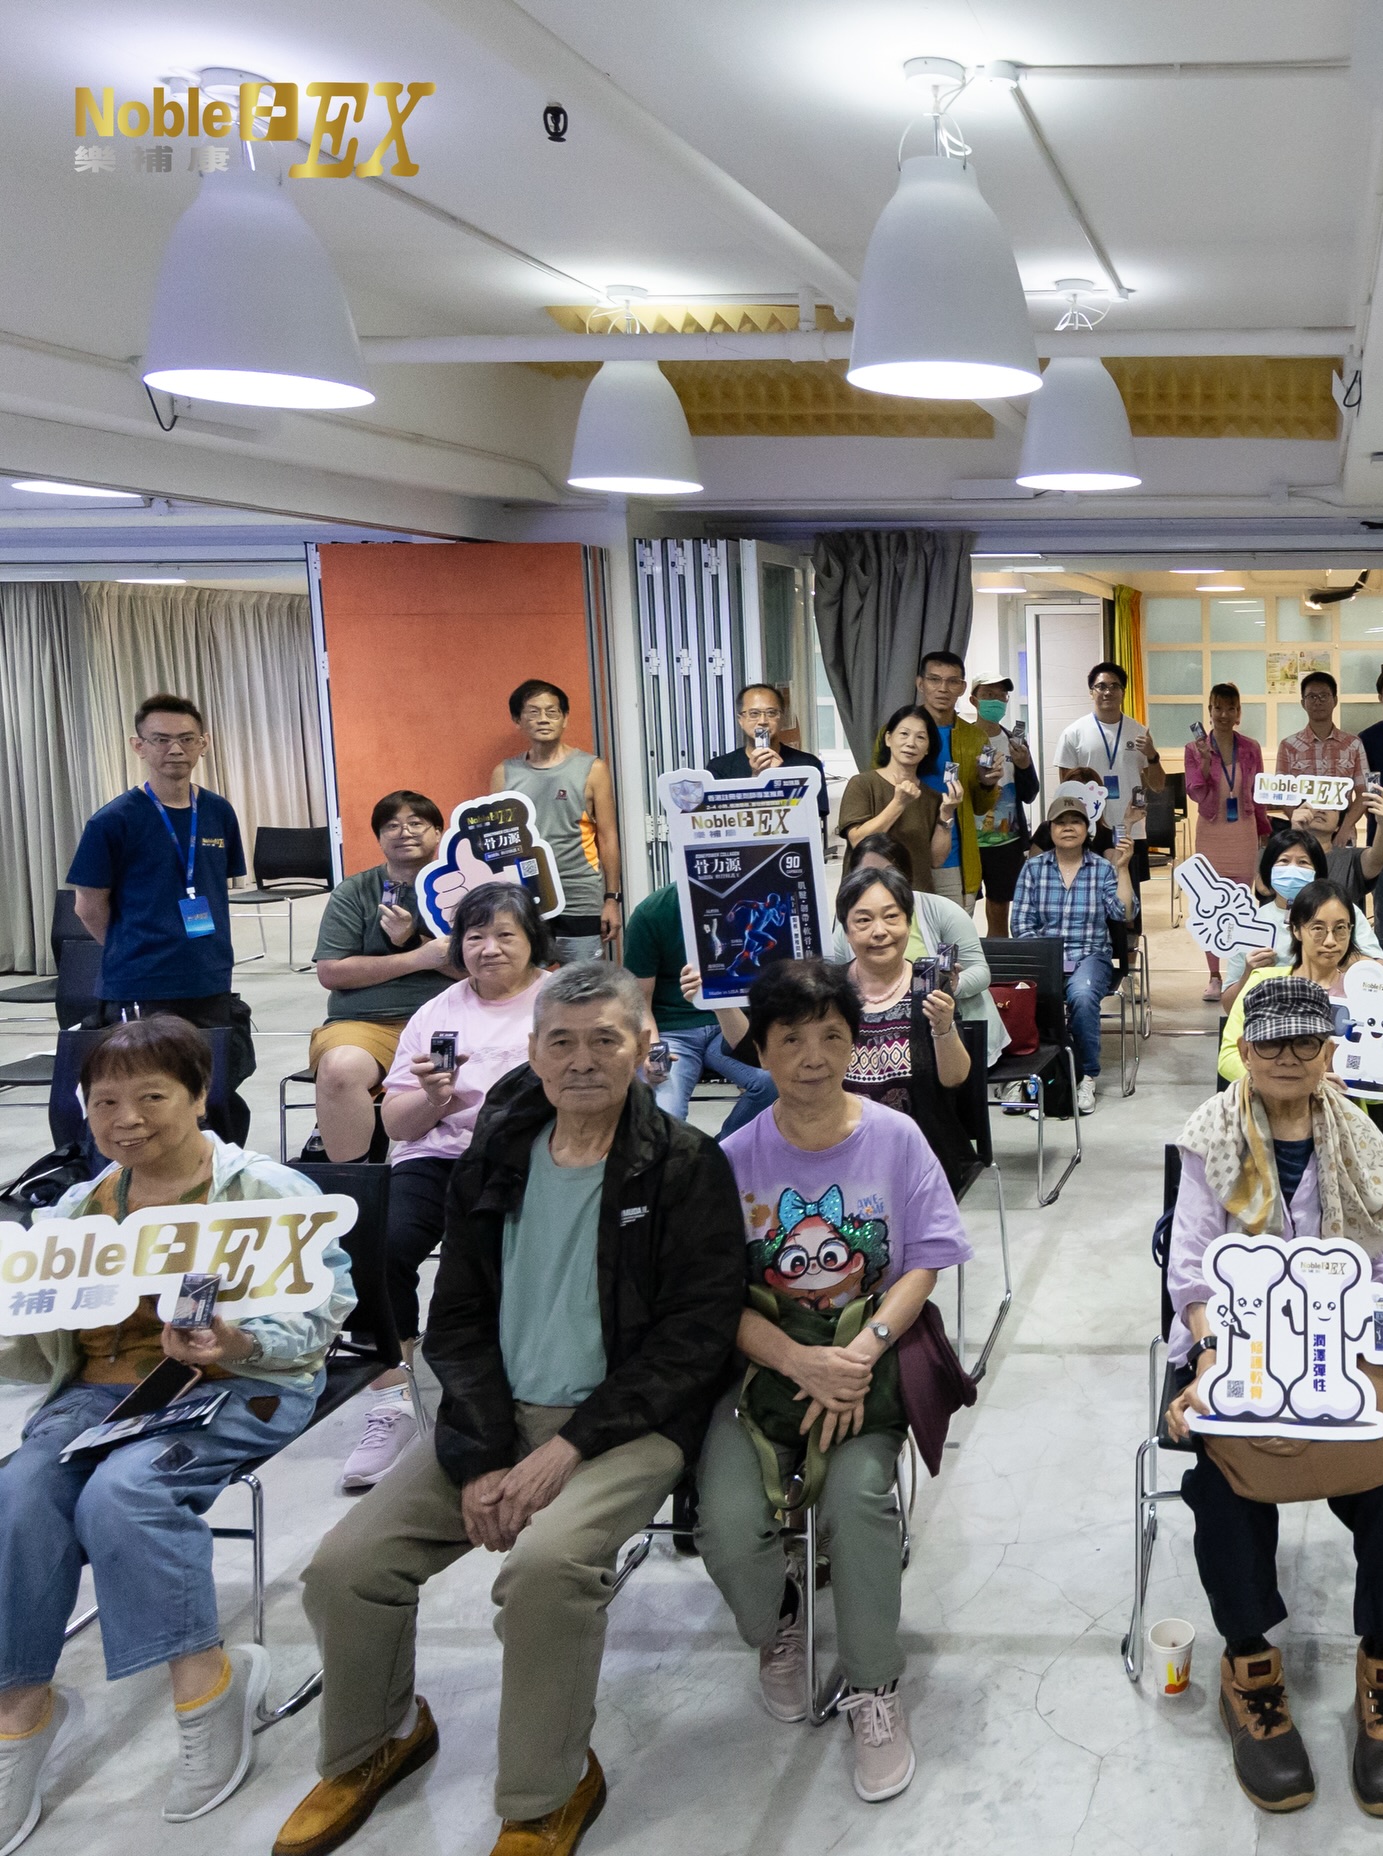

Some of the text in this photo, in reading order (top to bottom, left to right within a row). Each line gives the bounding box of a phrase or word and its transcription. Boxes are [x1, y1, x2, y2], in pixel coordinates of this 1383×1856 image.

[1259, 778, 1349, 805] Noble EX
[691, 808, 791, 836] Noble EX
[484, 831, 521, 850] 骨力源
[694, 857, 742, 875] 骨力源
[786, 856, 800, 869] 90
[0, 1211, 339, 1302] oble EX
[1328, 1262, 1347, 1275] EX
[9, 1284, 120, 1316] 補康
[1313, 1333, 1327, 1392] 潤澤彈性
